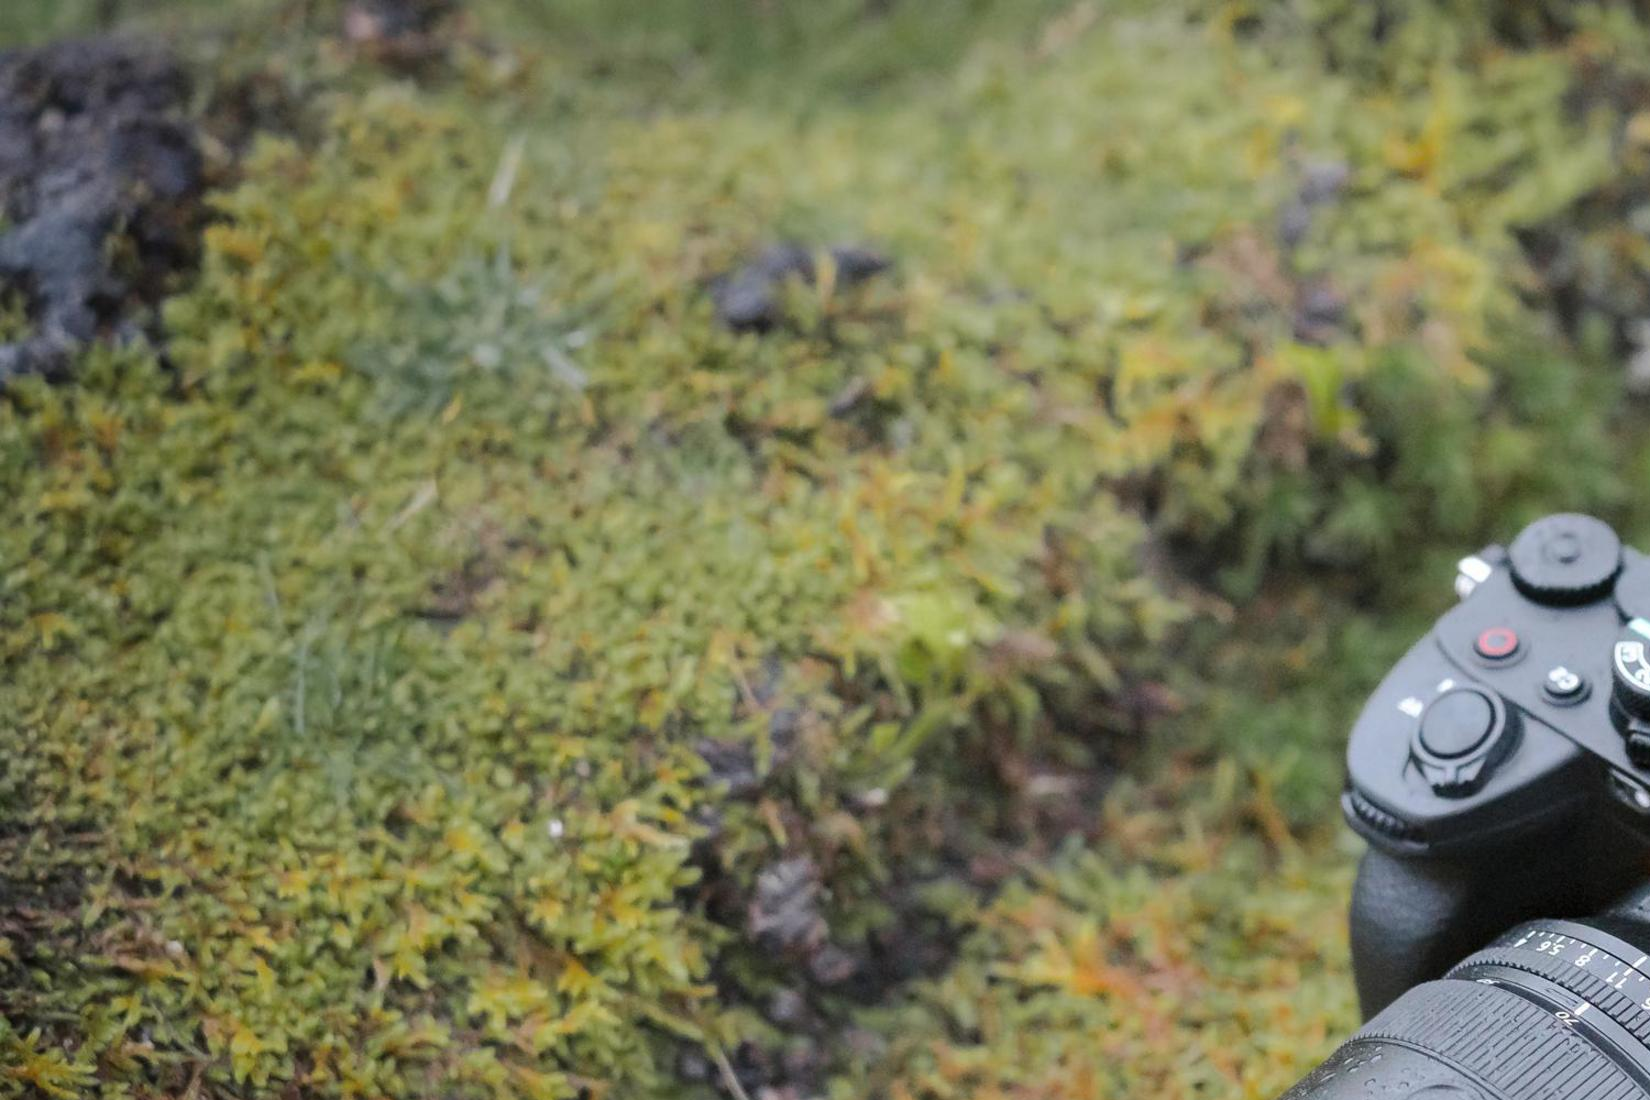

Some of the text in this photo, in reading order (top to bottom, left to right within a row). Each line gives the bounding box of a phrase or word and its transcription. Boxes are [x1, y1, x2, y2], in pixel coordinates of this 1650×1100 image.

[1536, 940, 1565, 956] 5.6
[1574, 955, 1592, 967] 8
[1605, 972, 1628, 989] 11
[1554, 1010, 1579, 1027] 70
